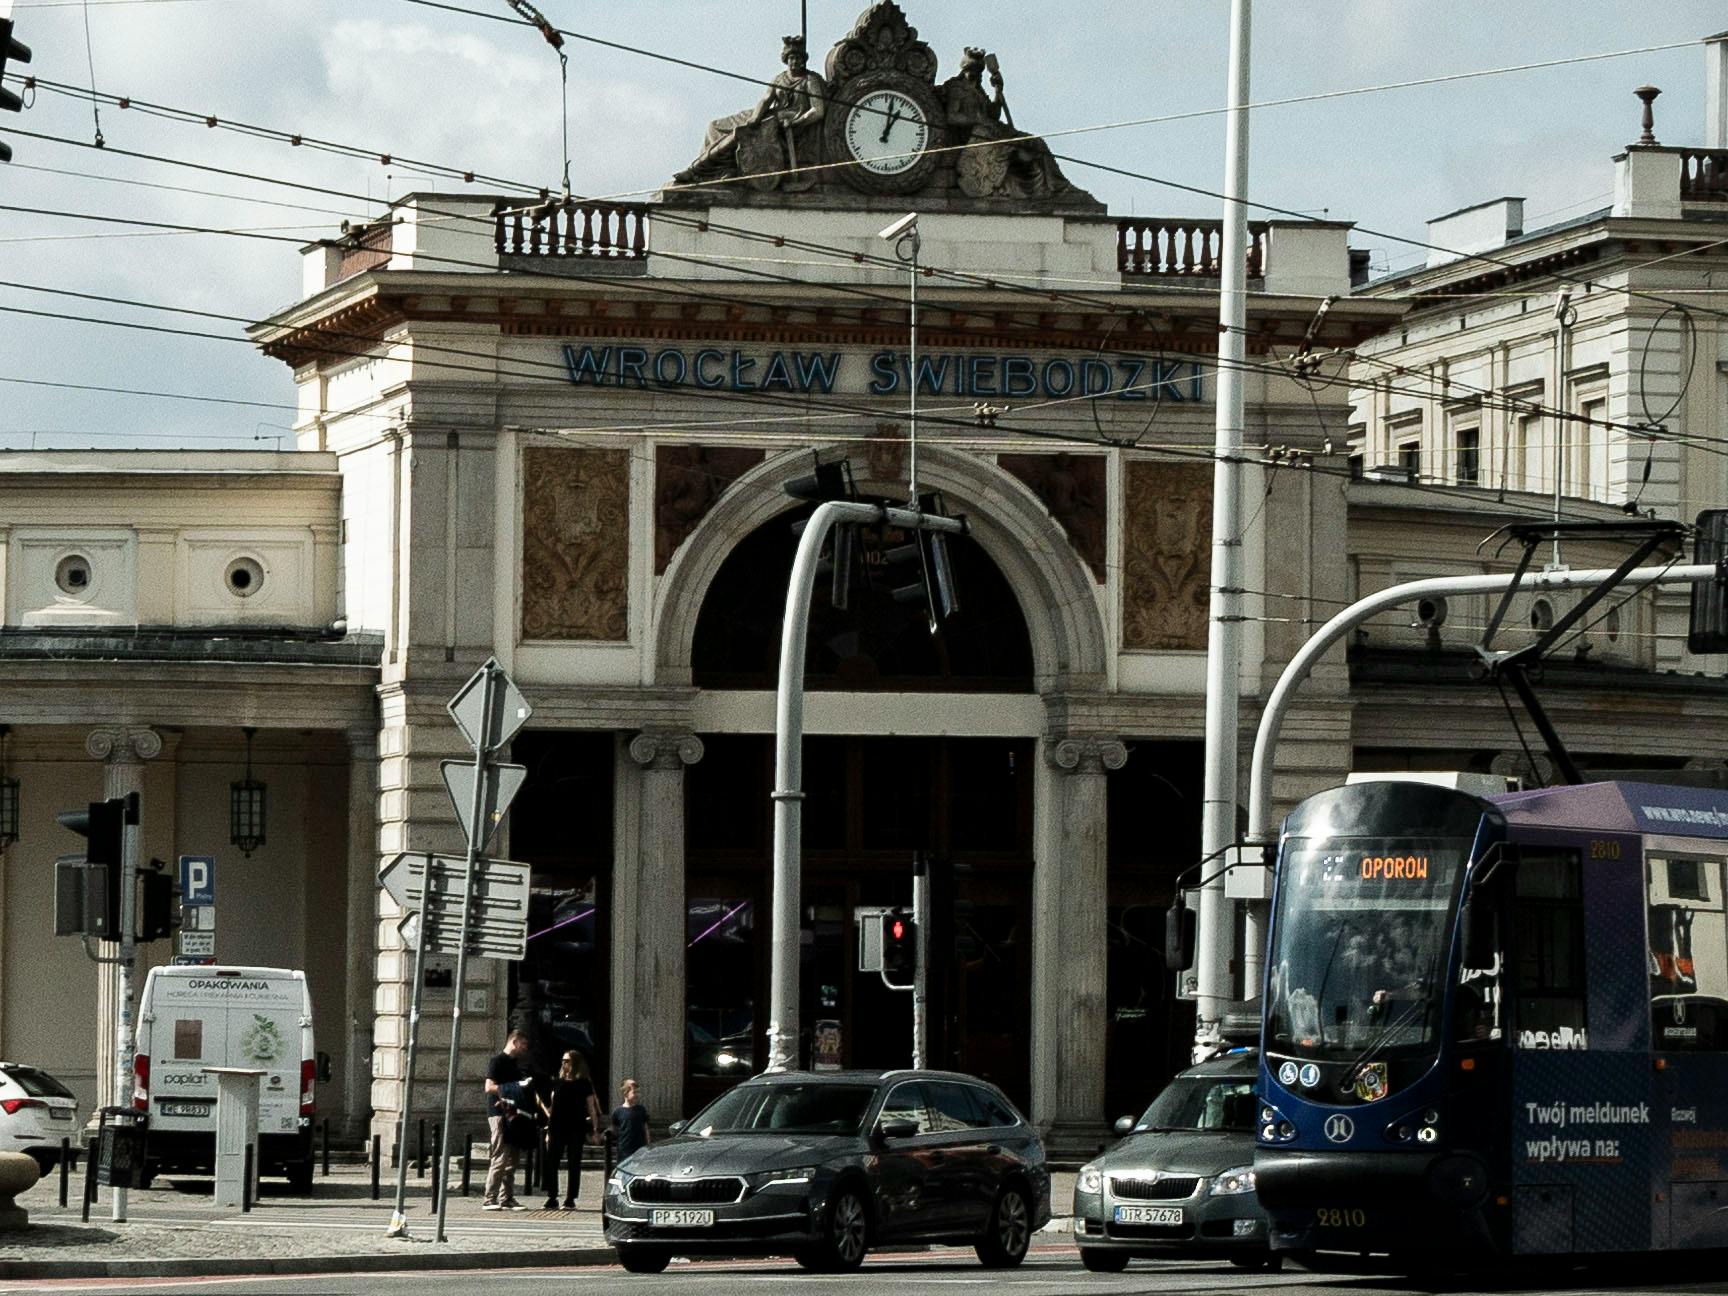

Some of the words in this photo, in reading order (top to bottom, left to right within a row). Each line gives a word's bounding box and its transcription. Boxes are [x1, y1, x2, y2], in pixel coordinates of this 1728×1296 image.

[563, 345, 842, 394] WROCŁAW
[1590, 840, 1620, 860] 2810
[189, 862, 208, 899] P
[189, 980, 269, 990] OPAKOWANIA
[1526, 1101, 1566, 1128] Twój
[1570, 1101, 1649, 1124] meldunek
[1526, 1135, 1590, 1162] wpływa
[1595, 1139, 1620, 1157] na:
[655, 1211, 670, 1223] PP
[674, 1211, 711, 1224] 5192U
[1145, 1209, 1181, 1222] 57678
[1316, 1208, 1365, 1227] 2810
